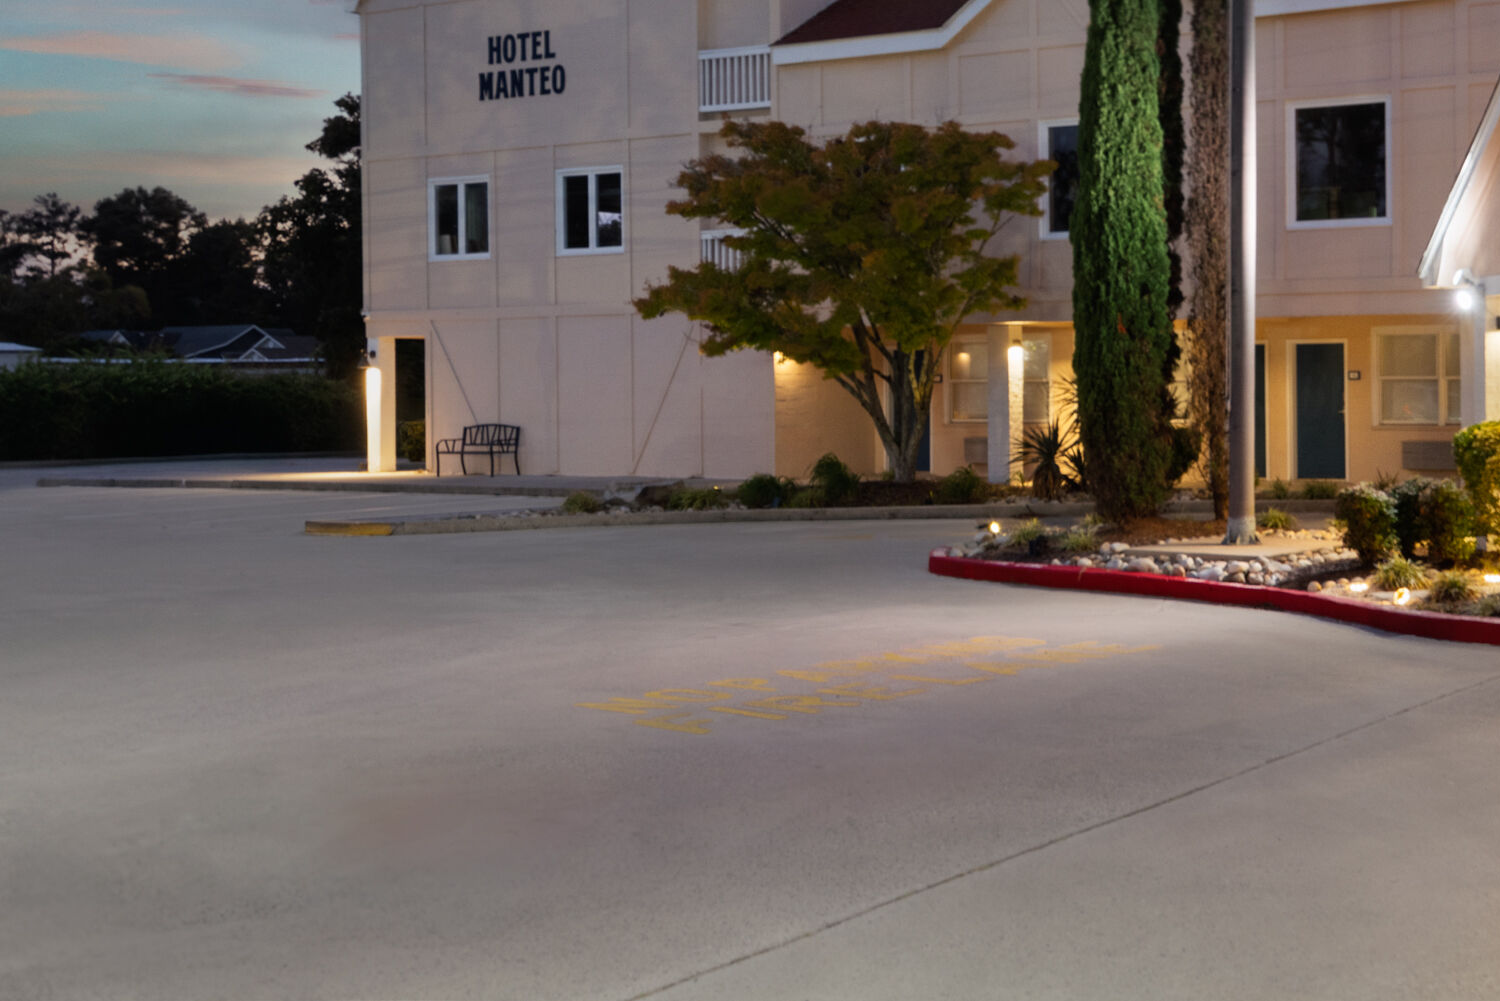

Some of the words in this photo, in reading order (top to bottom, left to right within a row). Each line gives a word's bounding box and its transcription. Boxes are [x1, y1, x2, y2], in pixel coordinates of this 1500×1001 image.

[487, 30, 556, 64] HOTEL
[478, 64, 566, 101] MANTEO
[573, 688, 733, 715] NO
[632, 681, 928, 735] FIRE
